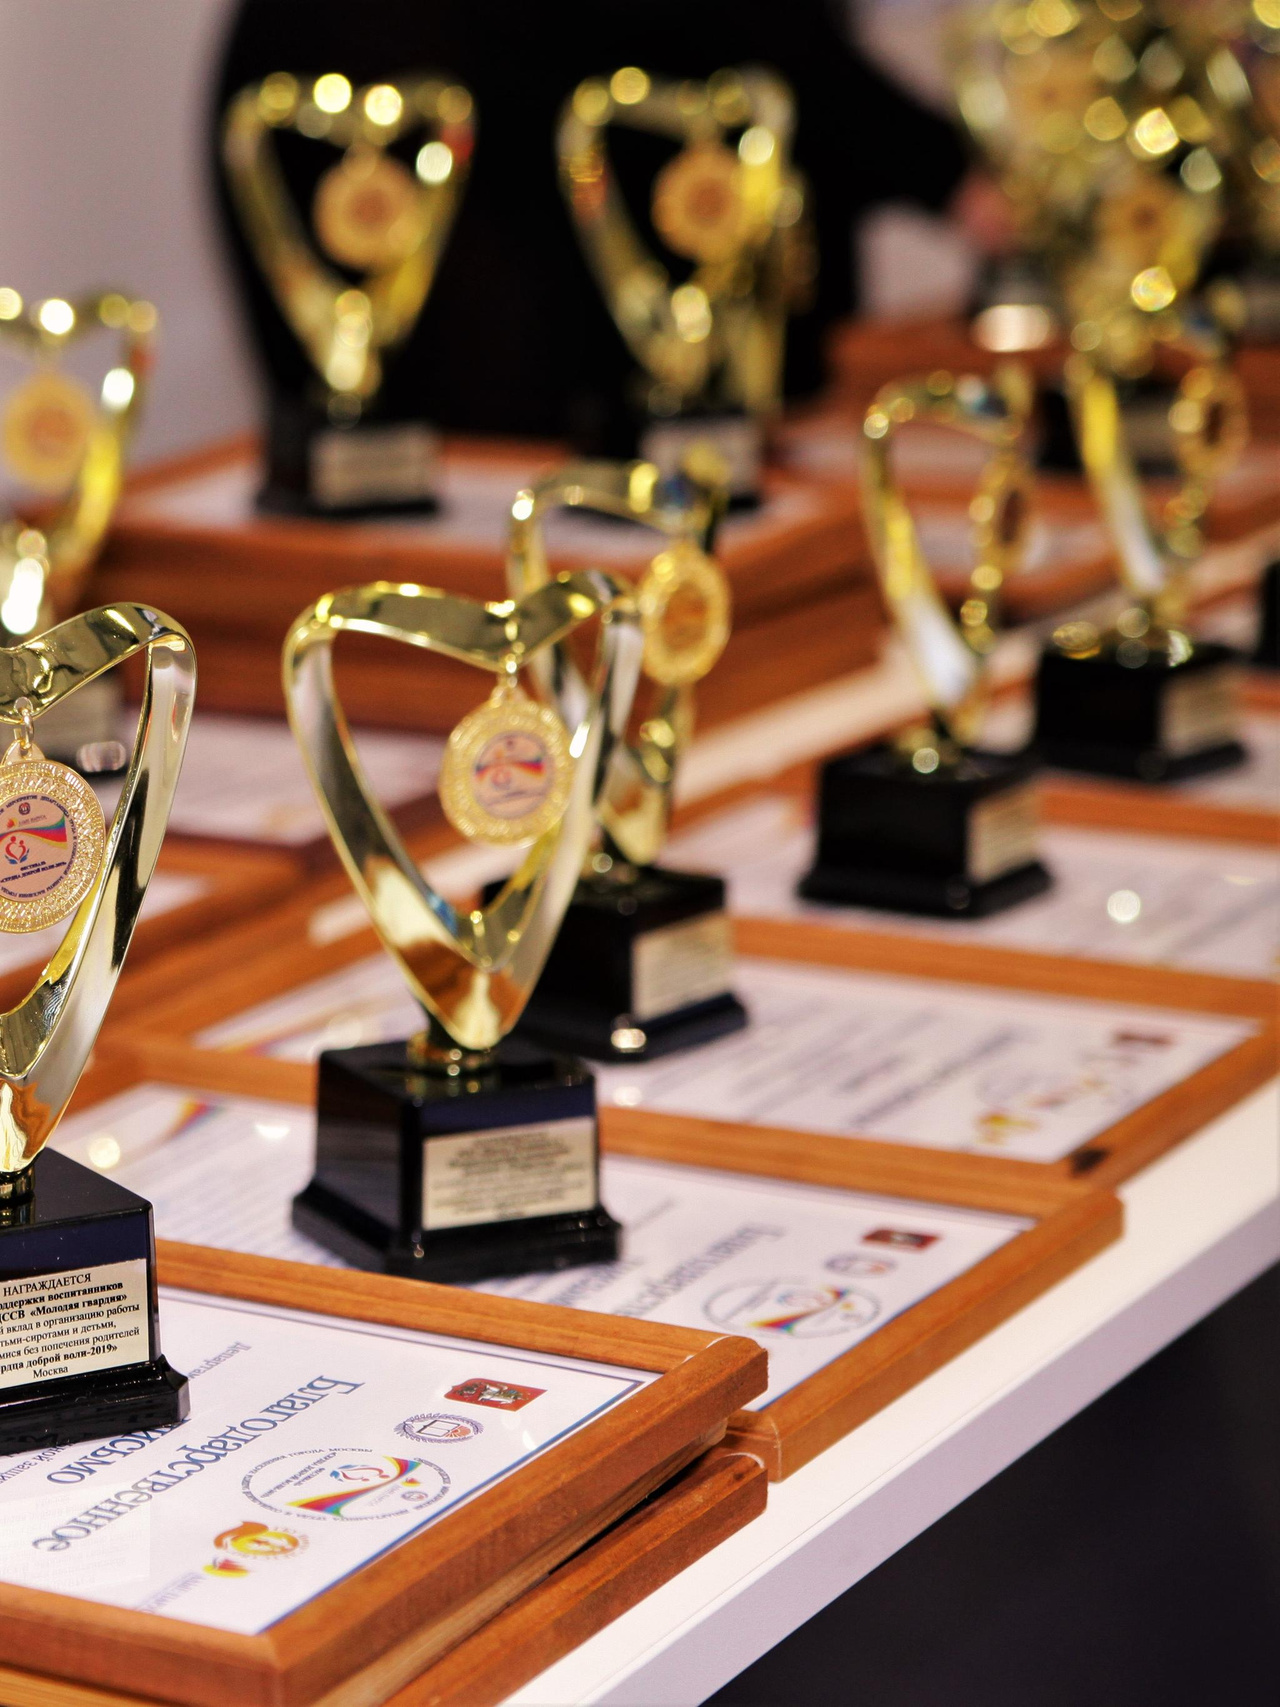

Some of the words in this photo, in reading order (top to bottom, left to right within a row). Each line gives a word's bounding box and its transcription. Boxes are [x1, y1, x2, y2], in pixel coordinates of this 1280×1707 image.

[3, 1273, 91, 1297] НАГРАЖДАЕТСЯ
[48, 1282, 123, 1301] воспитанников
[30, 1302, 79, 1317] «Молодая
[82, 1293, 127, 1310] гвардия»
[6, 1322, 33, 1334] вклад
[36, 1320, 41, 1328] в
[44, 1311, 104, 1328] организацию
[107, 1303, 140, 1320] работы
[81, 1321, 116, 1336] детьми,
[24, 1345, 39, 1355] без
[41, 1338, 90, 1351] попечения
[92, 1328, 140, 1346] родителей
[26, 1354, 60, 1368] доброй
[64, 1344, 117, 1361] воли-2019»
[176, 1341, 257, 1379] Департам
[33, 1365, 68, 1379] Москва
[32, 1375, 365, 1551] Благодарственное
[36, 1419, 193, 1487] исьмо
